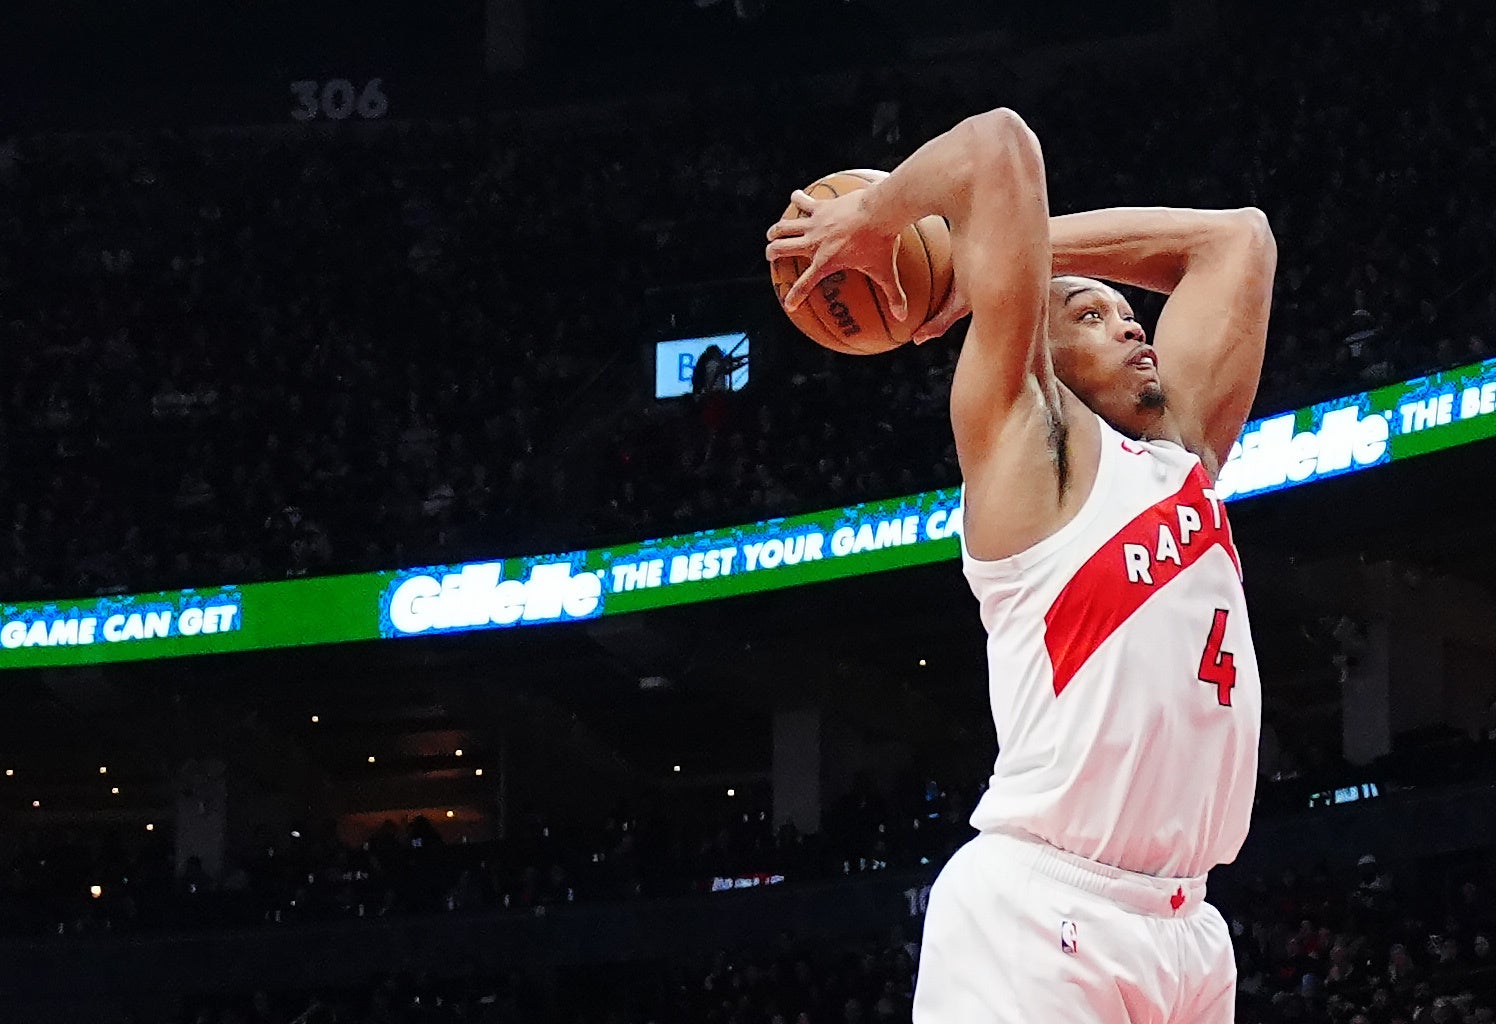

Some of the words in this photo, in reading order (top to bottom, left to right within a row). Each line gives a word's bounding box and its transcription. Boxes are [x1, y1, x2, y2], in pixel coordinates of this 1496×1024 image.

[290, 77, 390, 121] 306
[1400, 393, 1454, 433] THE
[389, 562, 602, 633] Gillette
[611, 559, 664, 592] THE
[669, 547, 737, 584] BEST
[743, 532, 824, 571] YOUR
[831, 515, 920, 557] GAME
[925, 508, 963, 540] CA
[1123, 488, 1243, 585] RAPT
[0, 617, 98, 649] GAME
[103, 611, 172, 642] CAN
[178, 605, 238, 636] GET
[1198, 608, 1237, 707] 4
